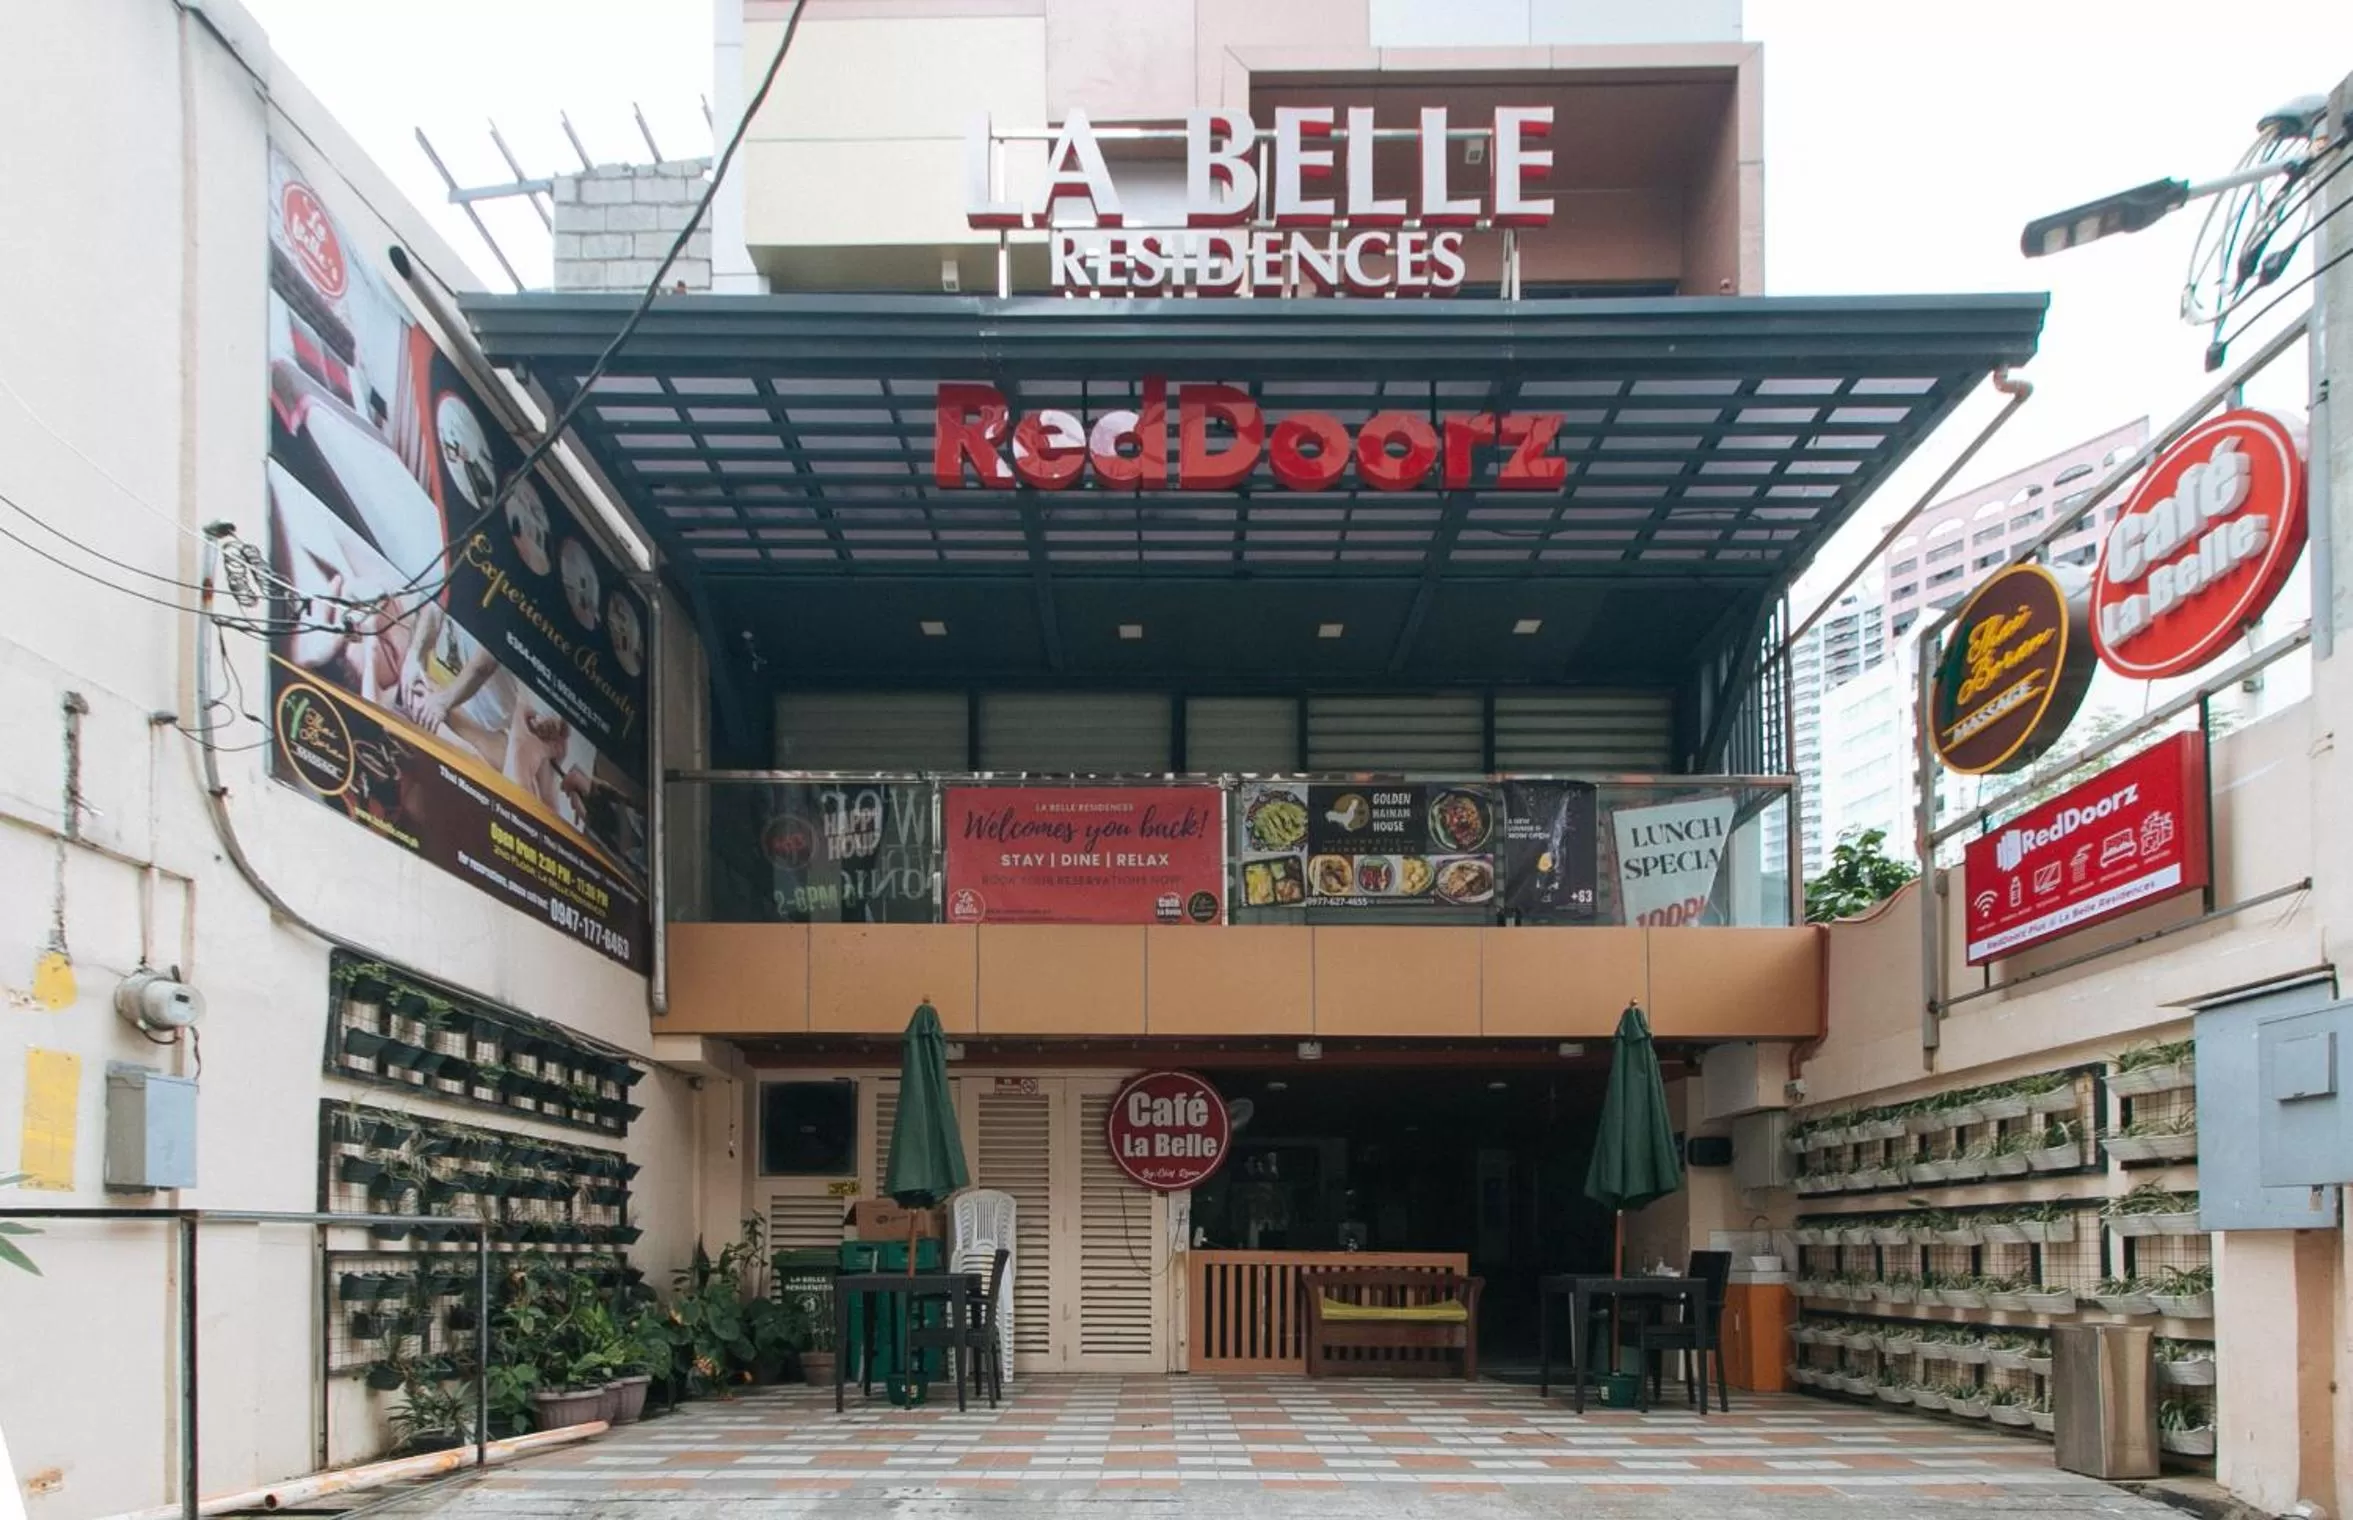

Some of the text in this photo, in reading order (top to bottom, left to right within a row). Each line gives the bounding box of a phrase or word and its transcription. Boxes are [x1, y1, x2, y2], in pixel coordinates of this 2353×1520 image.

[966, 106, 1555, 228] LA BELLE
[1051, 231, 1466, 296] RESIDENCES
[934, 375, 1569, 491] RedDoorz
[2108, 436, 2251, 584] Café
[465, 530, 571, 656] Experience
[2102, 514, 2270, 648] La Belle
[1372, 808, 1411, 819] HAINAN
[1373, 792, 1411, 805] GOLDEN
[2021, 783, 2138, 854] RedDoorz
[964, 804, 1209, 853] Welcomes you back!
[1373, 821, 1404, 832] HOUSE
[1631, 816, 1722, 848] LUNCH
[1001, 853, 1169, 867] STAY DINE RELAX
[1623, 847, 1720, 880] SPECIA
[2059, 911, 2069, 923] La
[2072, 902, 2096, 917] Belle
[2098, 880, 2156, 908] Residences
[1128, 1091, 1208, 1127] Café
[1123, 1133, 1217, 1157] La Belle
